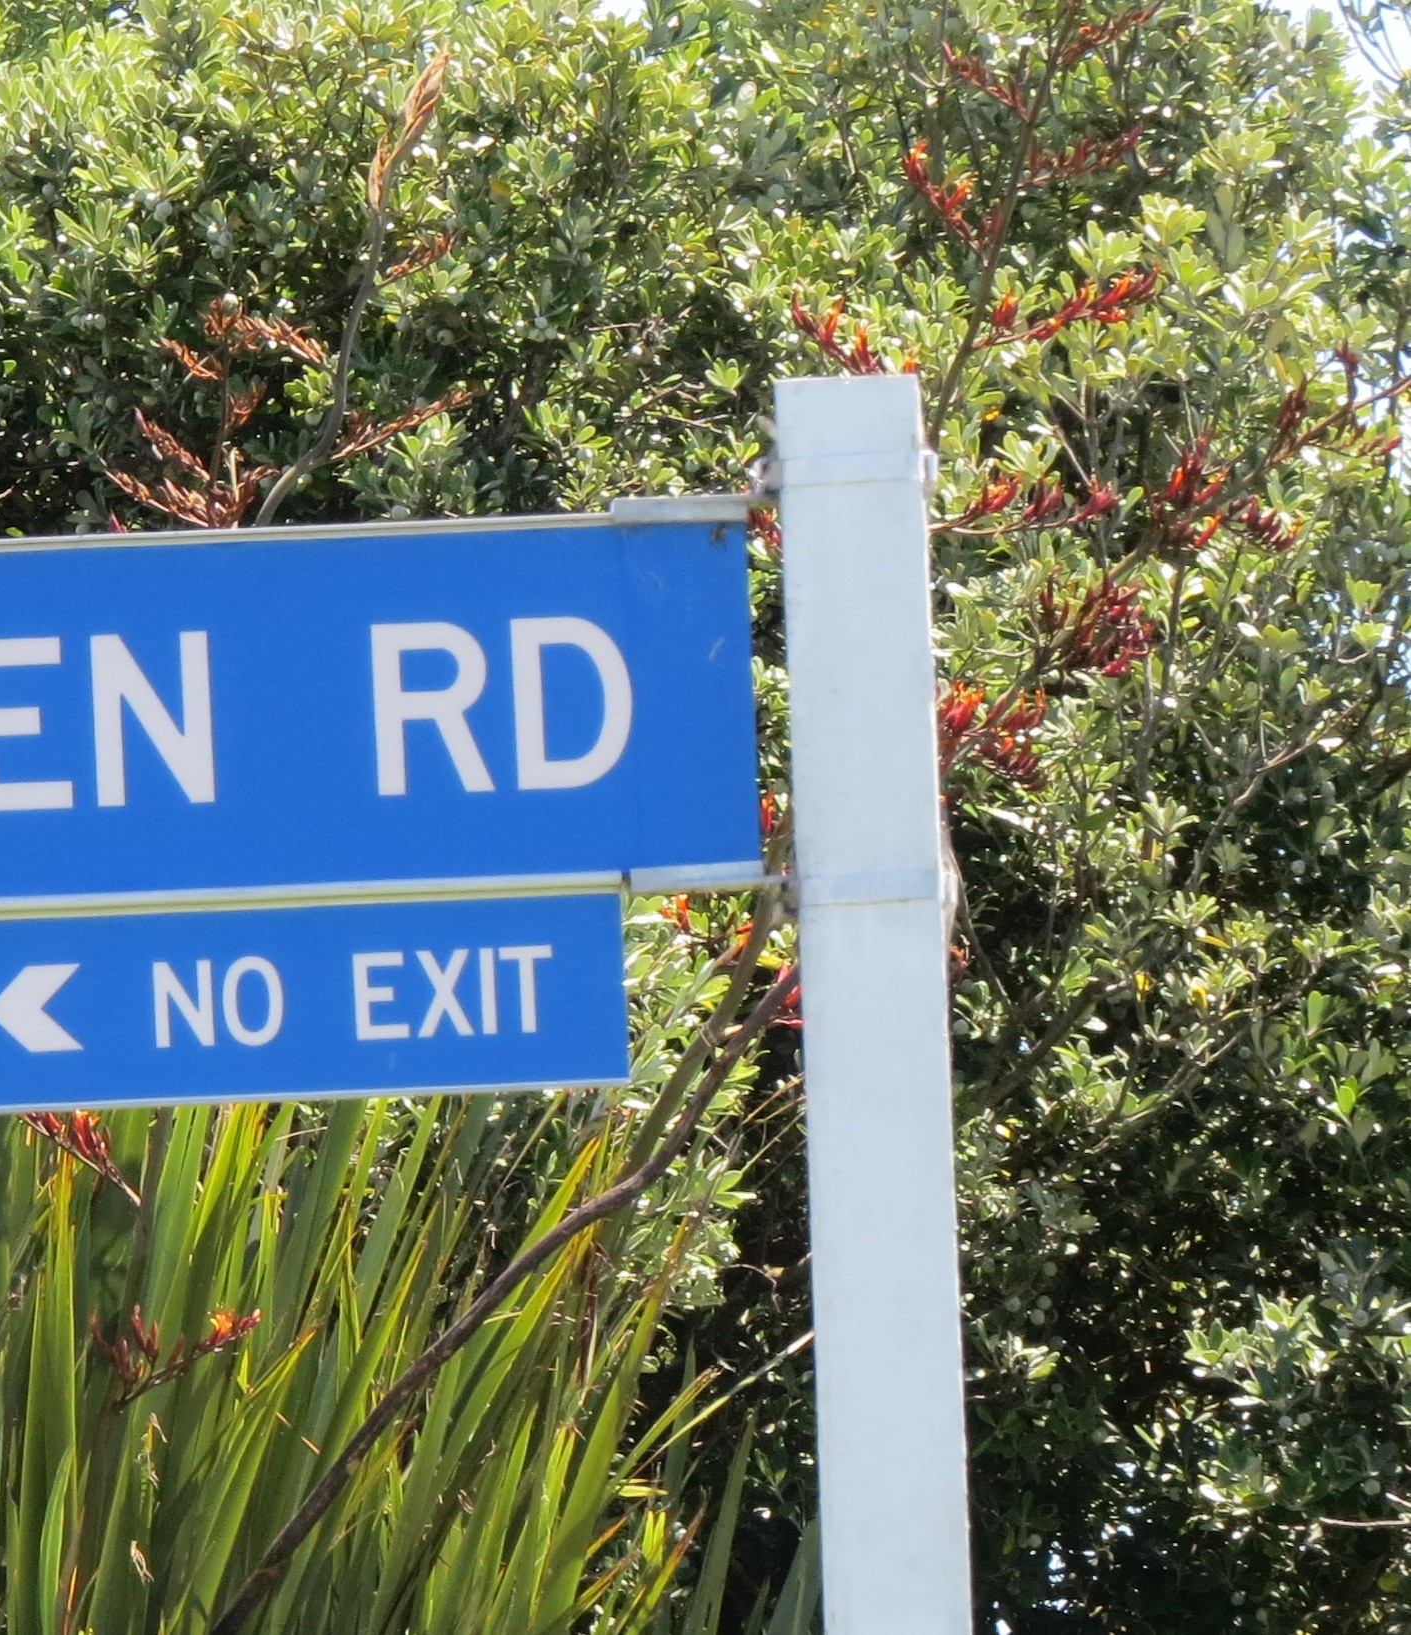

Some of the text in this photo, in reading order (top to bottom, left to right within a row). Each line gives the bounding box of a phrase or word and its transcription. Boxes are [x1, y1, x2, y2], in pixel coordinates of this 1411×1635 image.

[371, 616, 633, 796] RD
[153, 945, 552, 1048] NO EXIT
